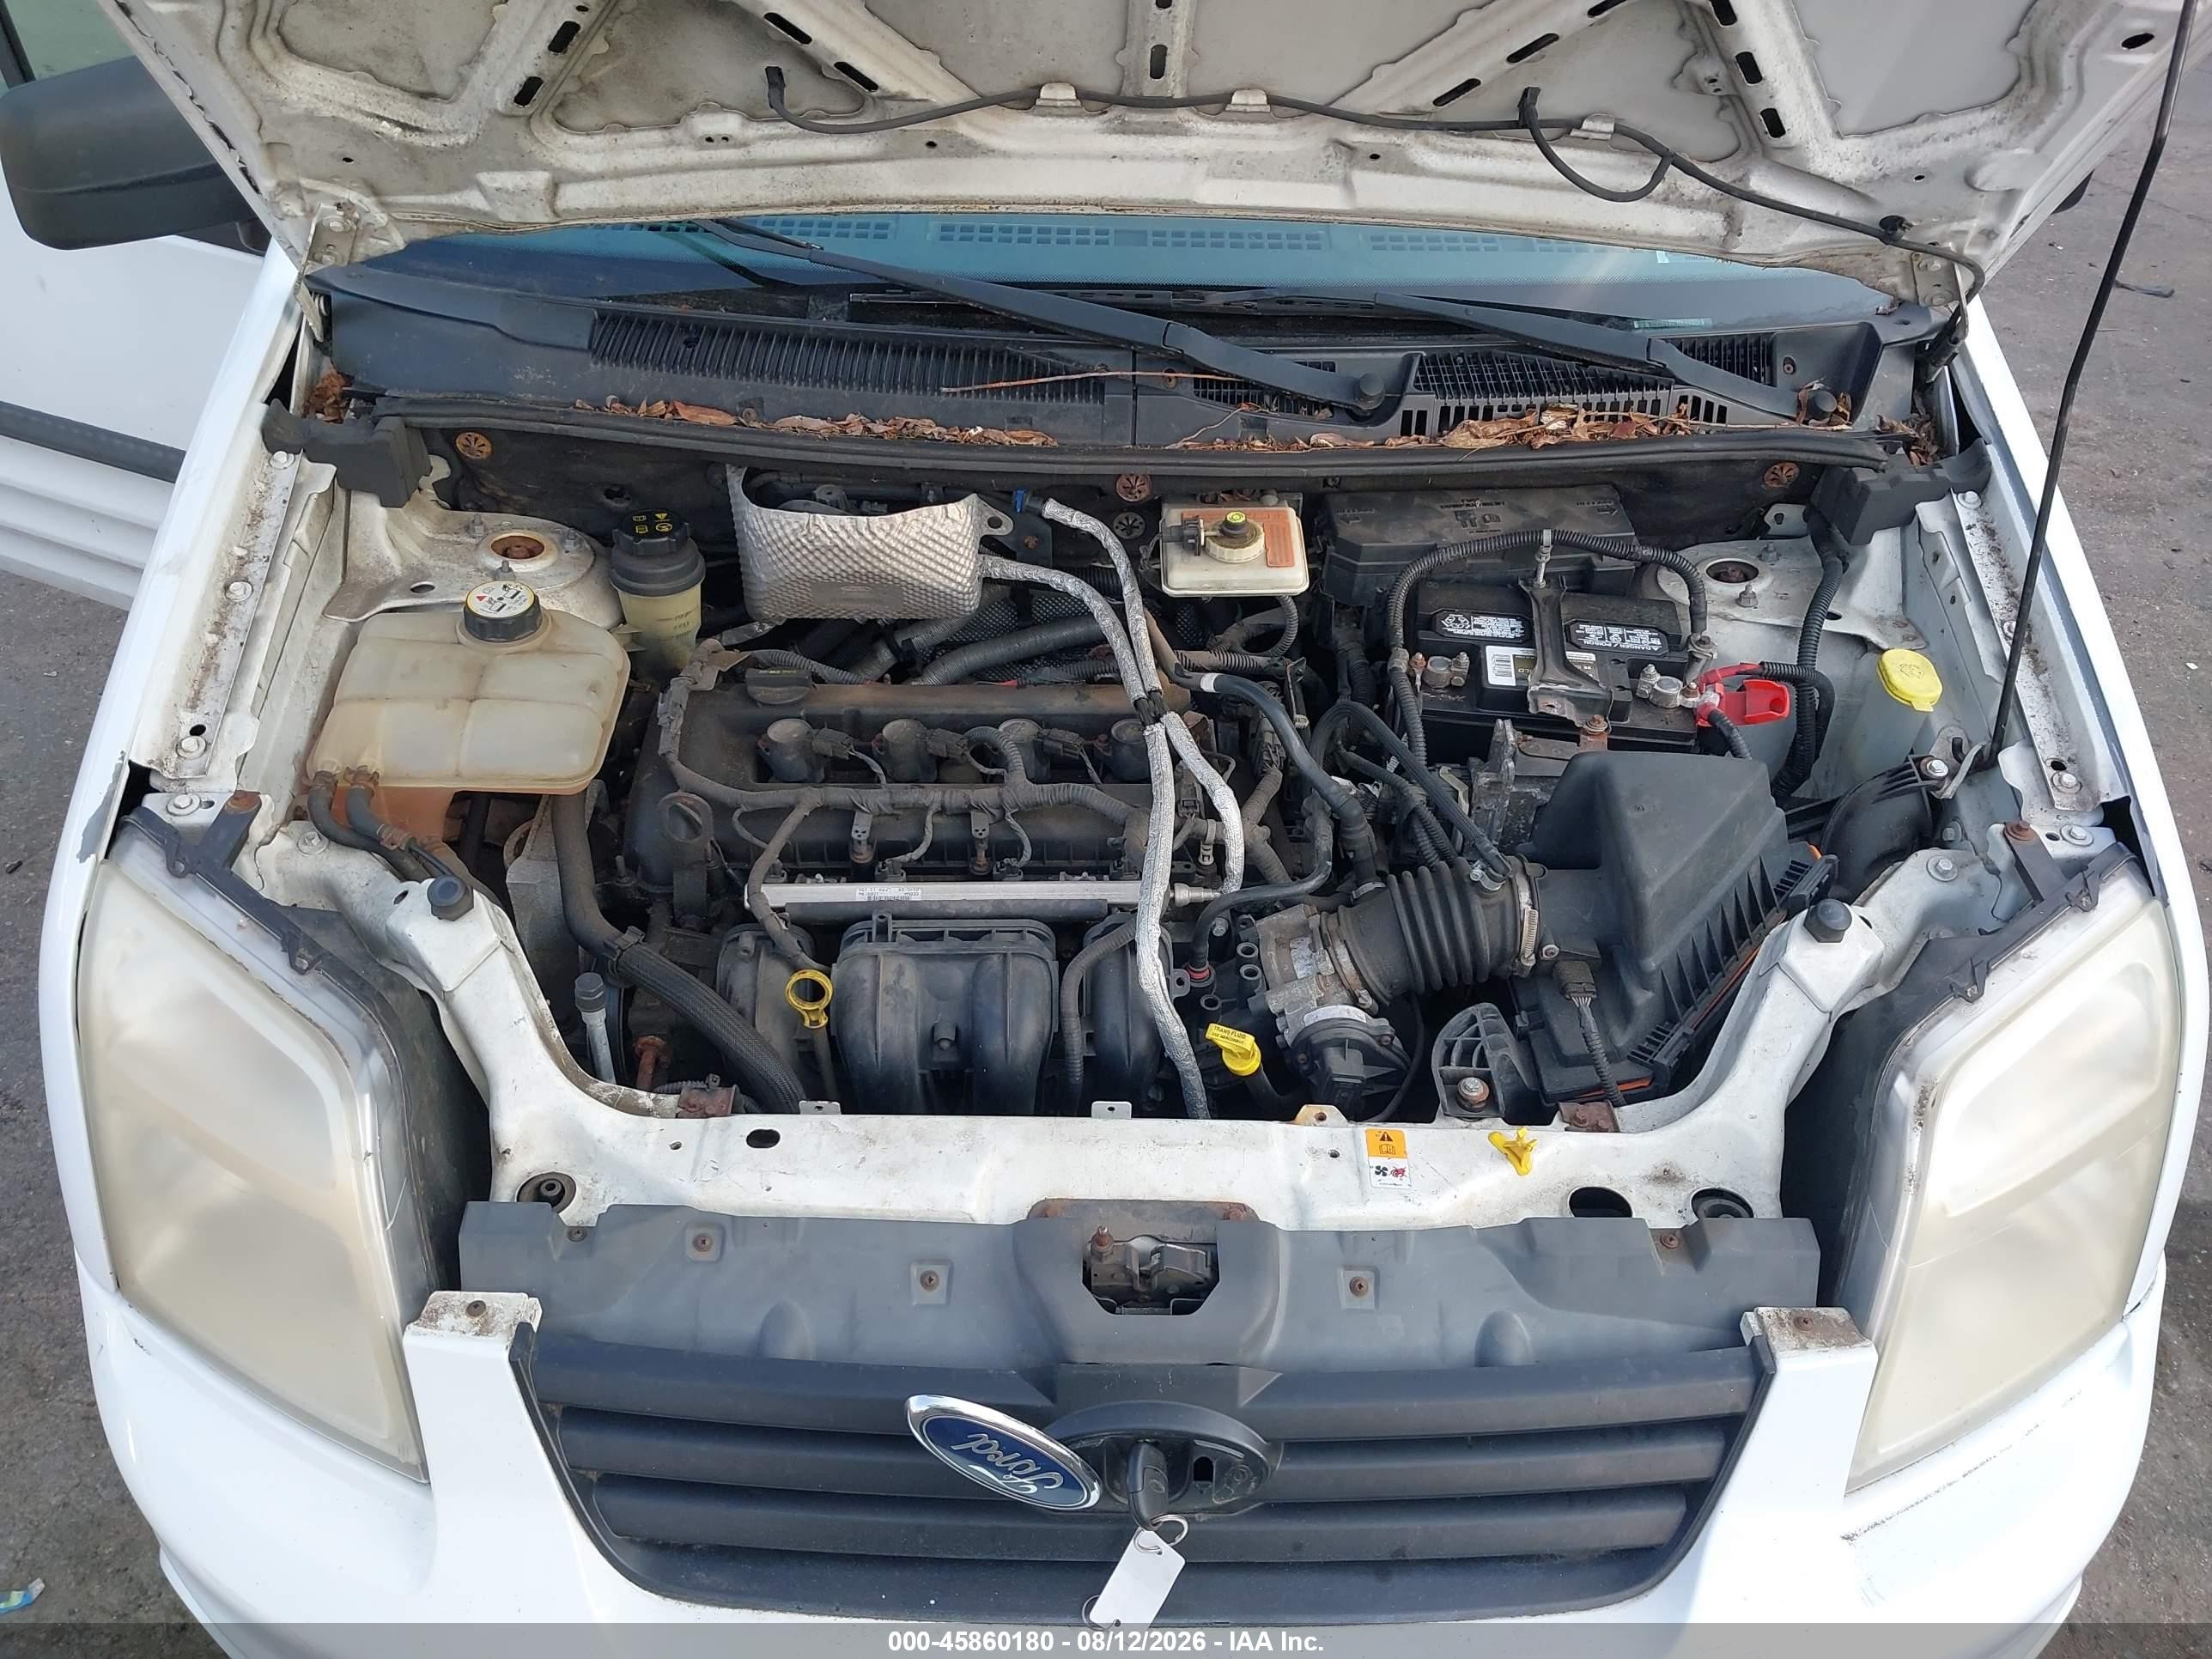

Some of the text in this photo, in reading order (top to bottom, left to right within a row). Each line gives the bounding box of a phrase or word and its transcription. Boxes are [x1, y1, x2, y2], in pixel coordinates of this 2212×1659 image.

[1583, 639, 1612, 647] POISON
[1620, 642, 1651, 651] DANGER
[1214, 1026, 1231, 1035] TRANS
[951, 1433, 1063, 1493] Ford
